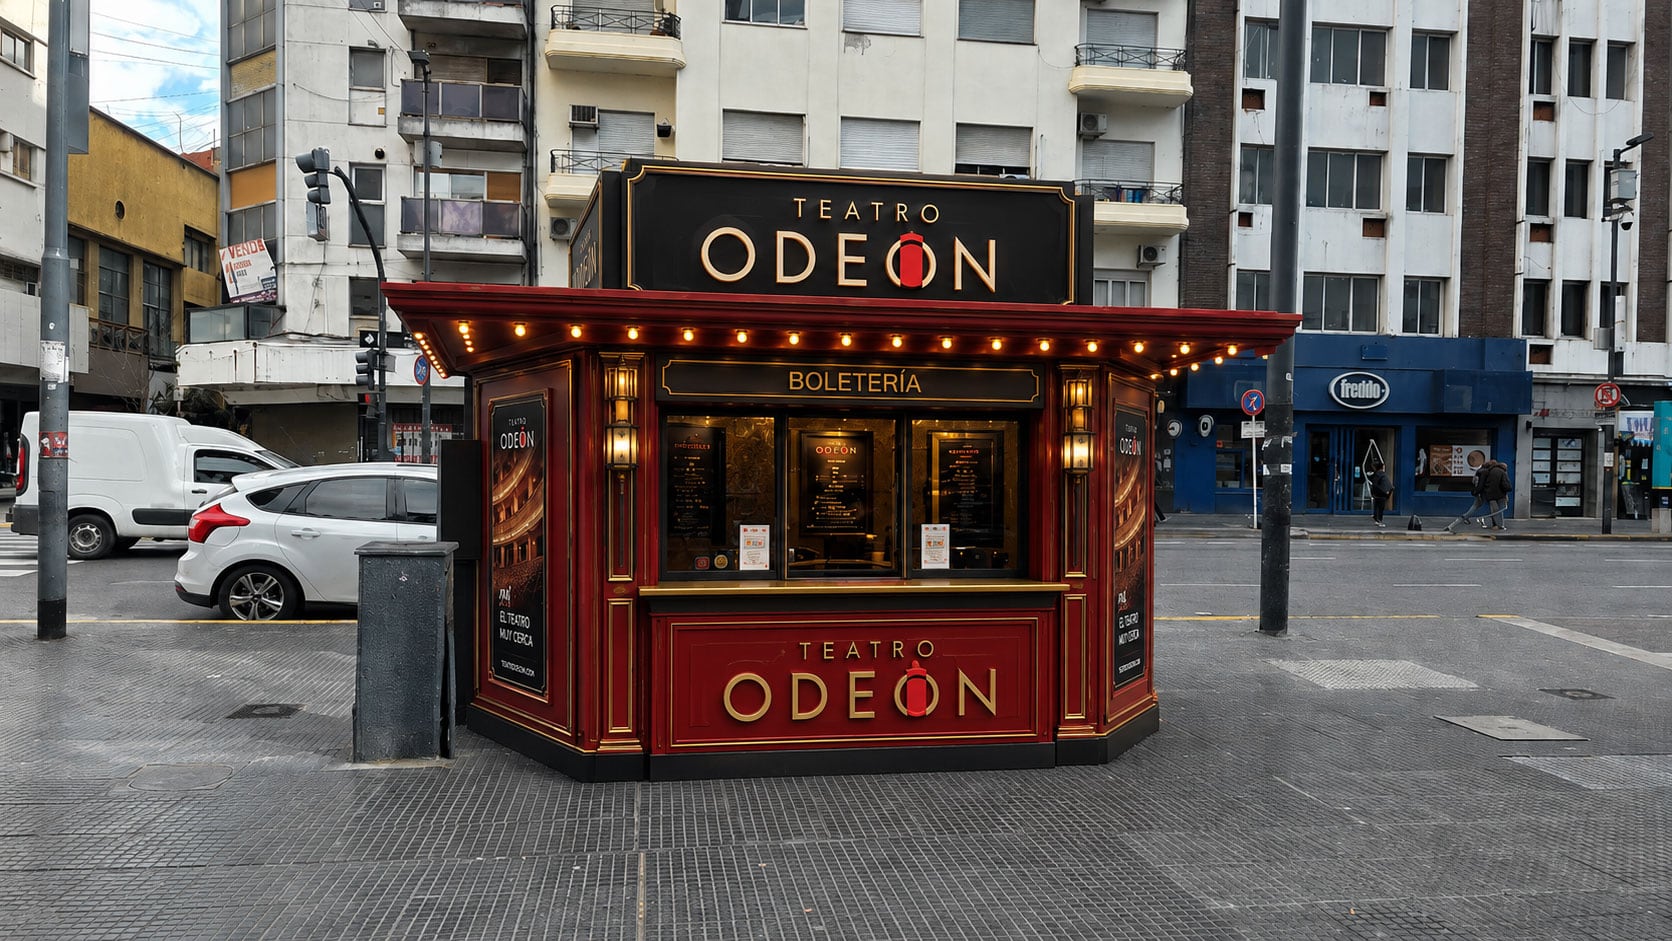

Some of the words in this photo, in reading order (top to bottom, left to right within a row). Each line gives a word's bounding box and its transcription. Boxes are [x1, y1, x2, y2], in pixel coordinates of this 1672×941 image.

[793, 198, 940, 224] TEATRO
[789, 368, 922, 393] BOLETERÍA
[1340, 378, 1381, 399] freddo
[799, 640, 935, 660] TEATRO
